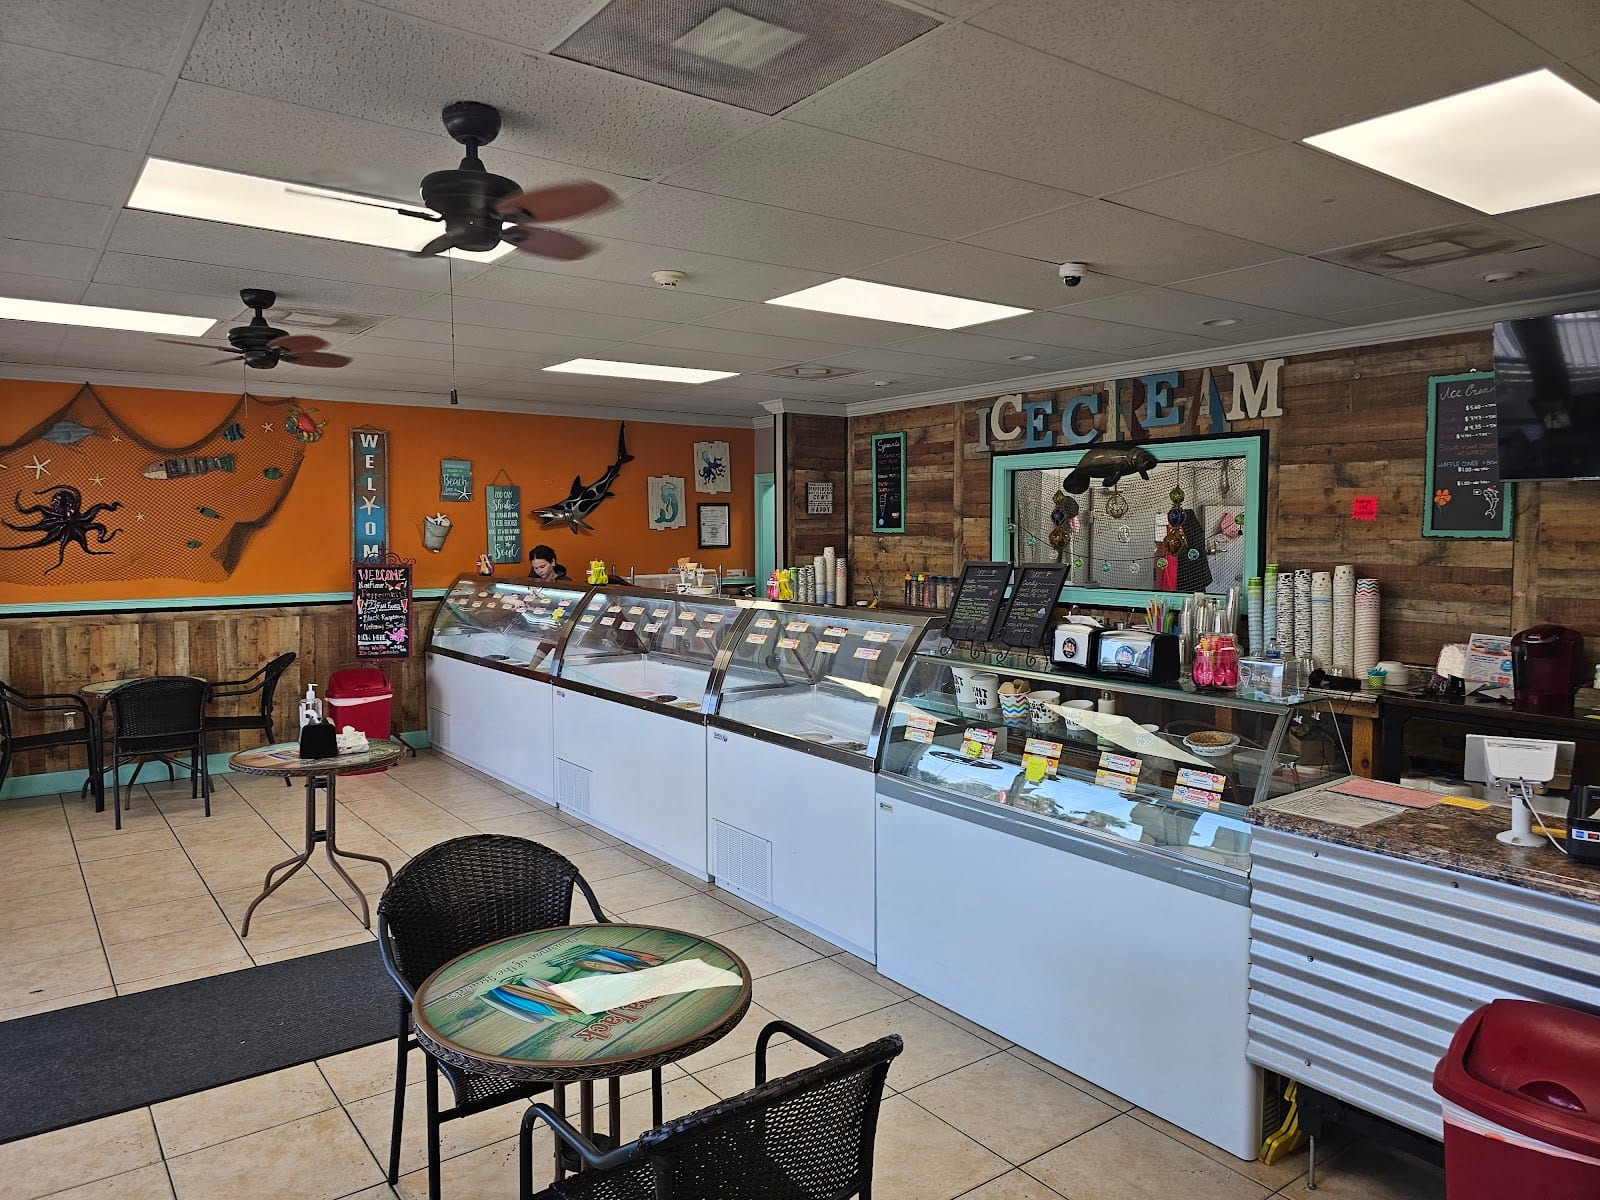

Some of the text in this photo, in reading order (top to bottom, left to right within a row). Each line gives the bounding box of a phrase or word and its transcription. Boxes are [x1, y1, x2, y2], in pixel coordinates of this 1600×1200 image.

[1439, 387, 1463, 400] Ice
[443, 473, 467, 487] Beach
[487, 499, 520, 511] Shake
[494, 543, 520, 559] Soul
[357, 568, 406, 581] WELCOME
[363, 614, 380, 622] Black
[511, 957, 528, 969] of
[495, 964, 515, 976] the
[573, 1007, 642, 1041] Jack
